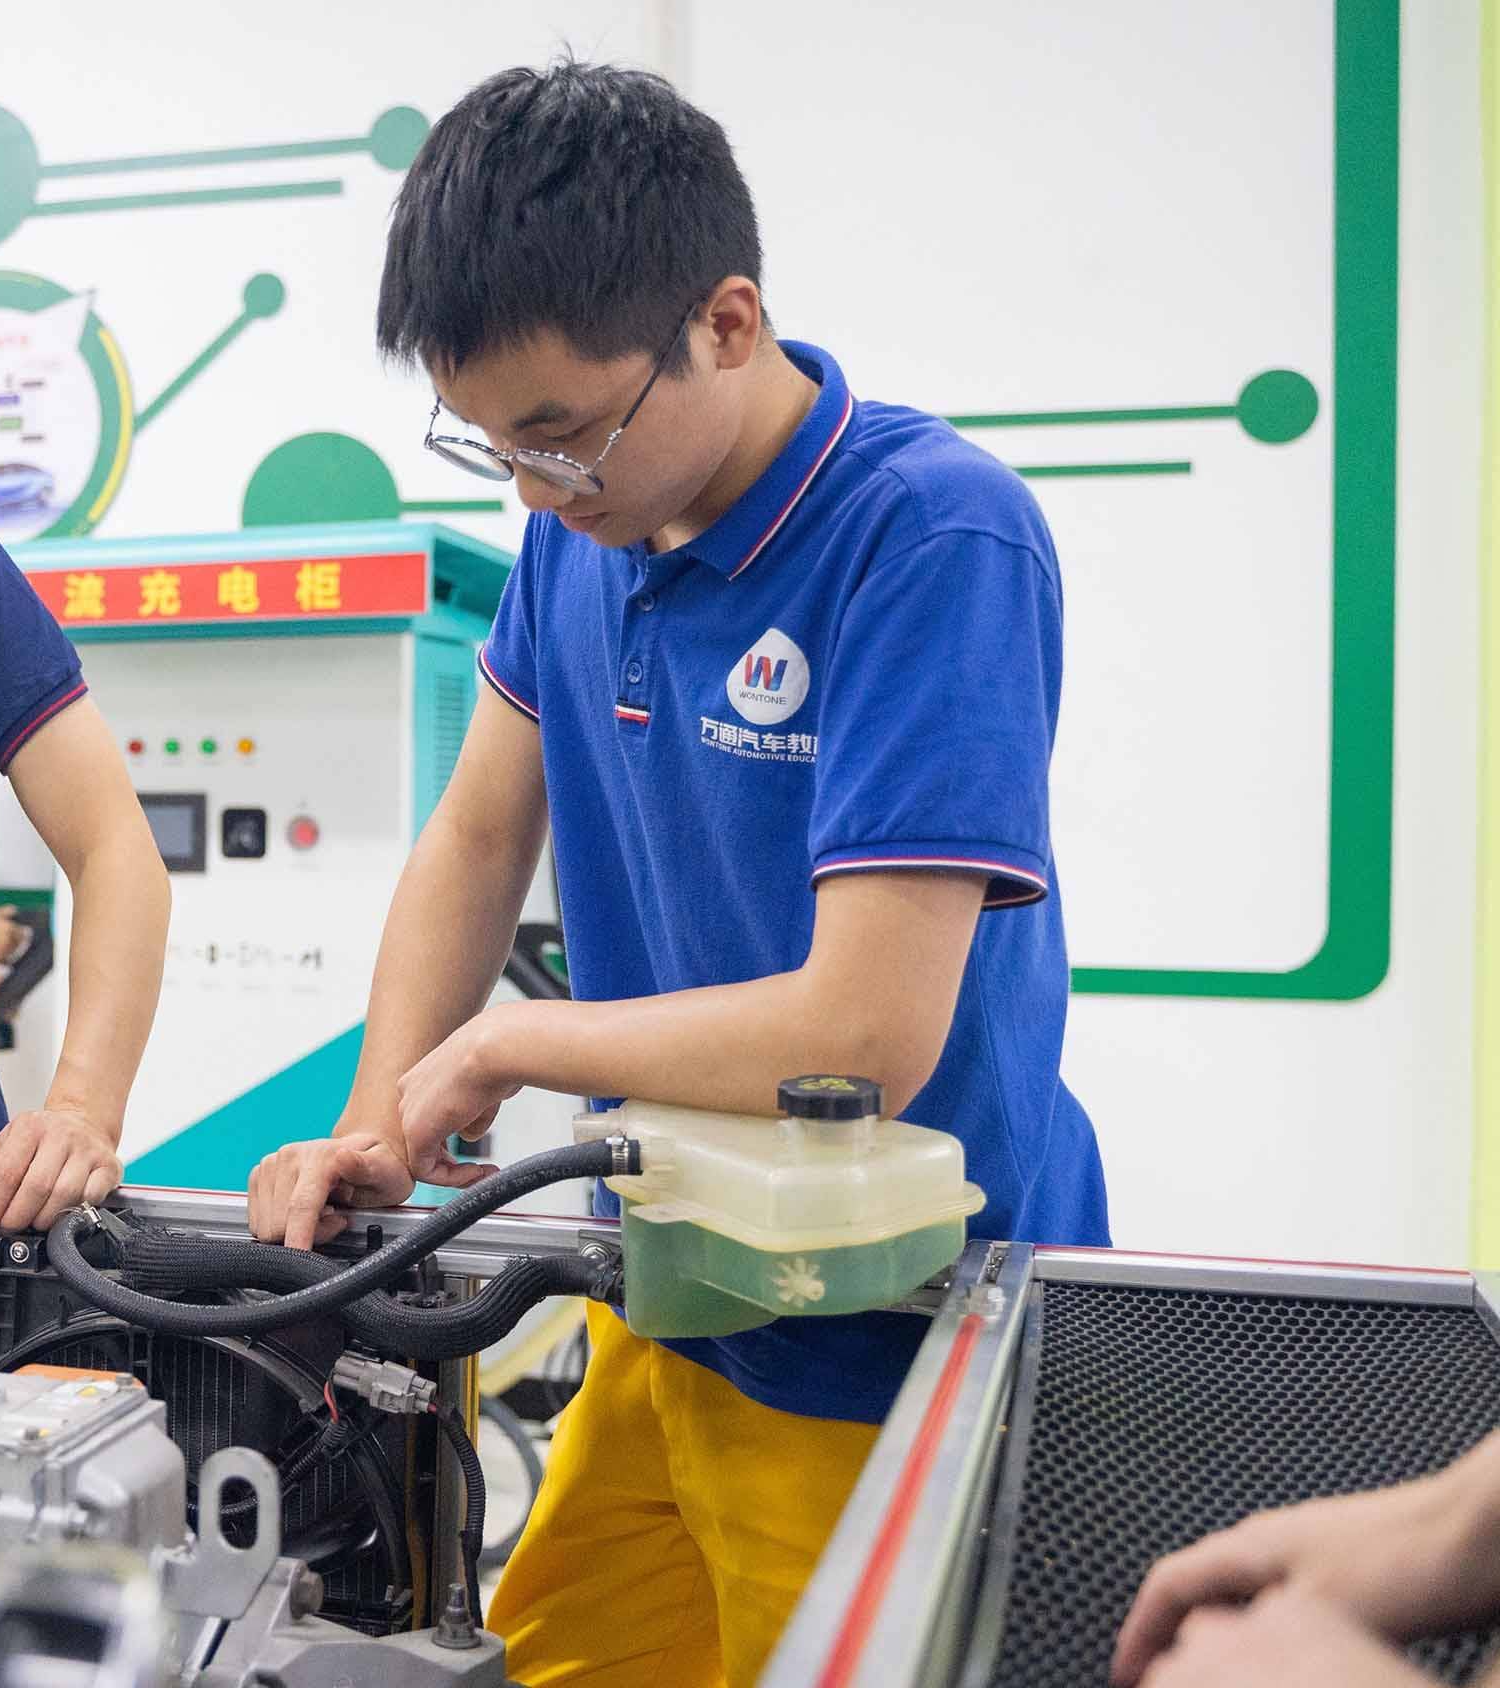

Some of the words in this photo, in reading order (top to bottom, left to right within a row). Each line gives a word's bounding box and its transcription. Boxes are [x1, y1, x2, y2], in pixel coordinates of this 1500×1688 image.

[64, 561, 342, 619] 流充电柜
[739, 690, 788, 705] WONTONE
[732, 747, 786, 761] AUTOMOTIVE
